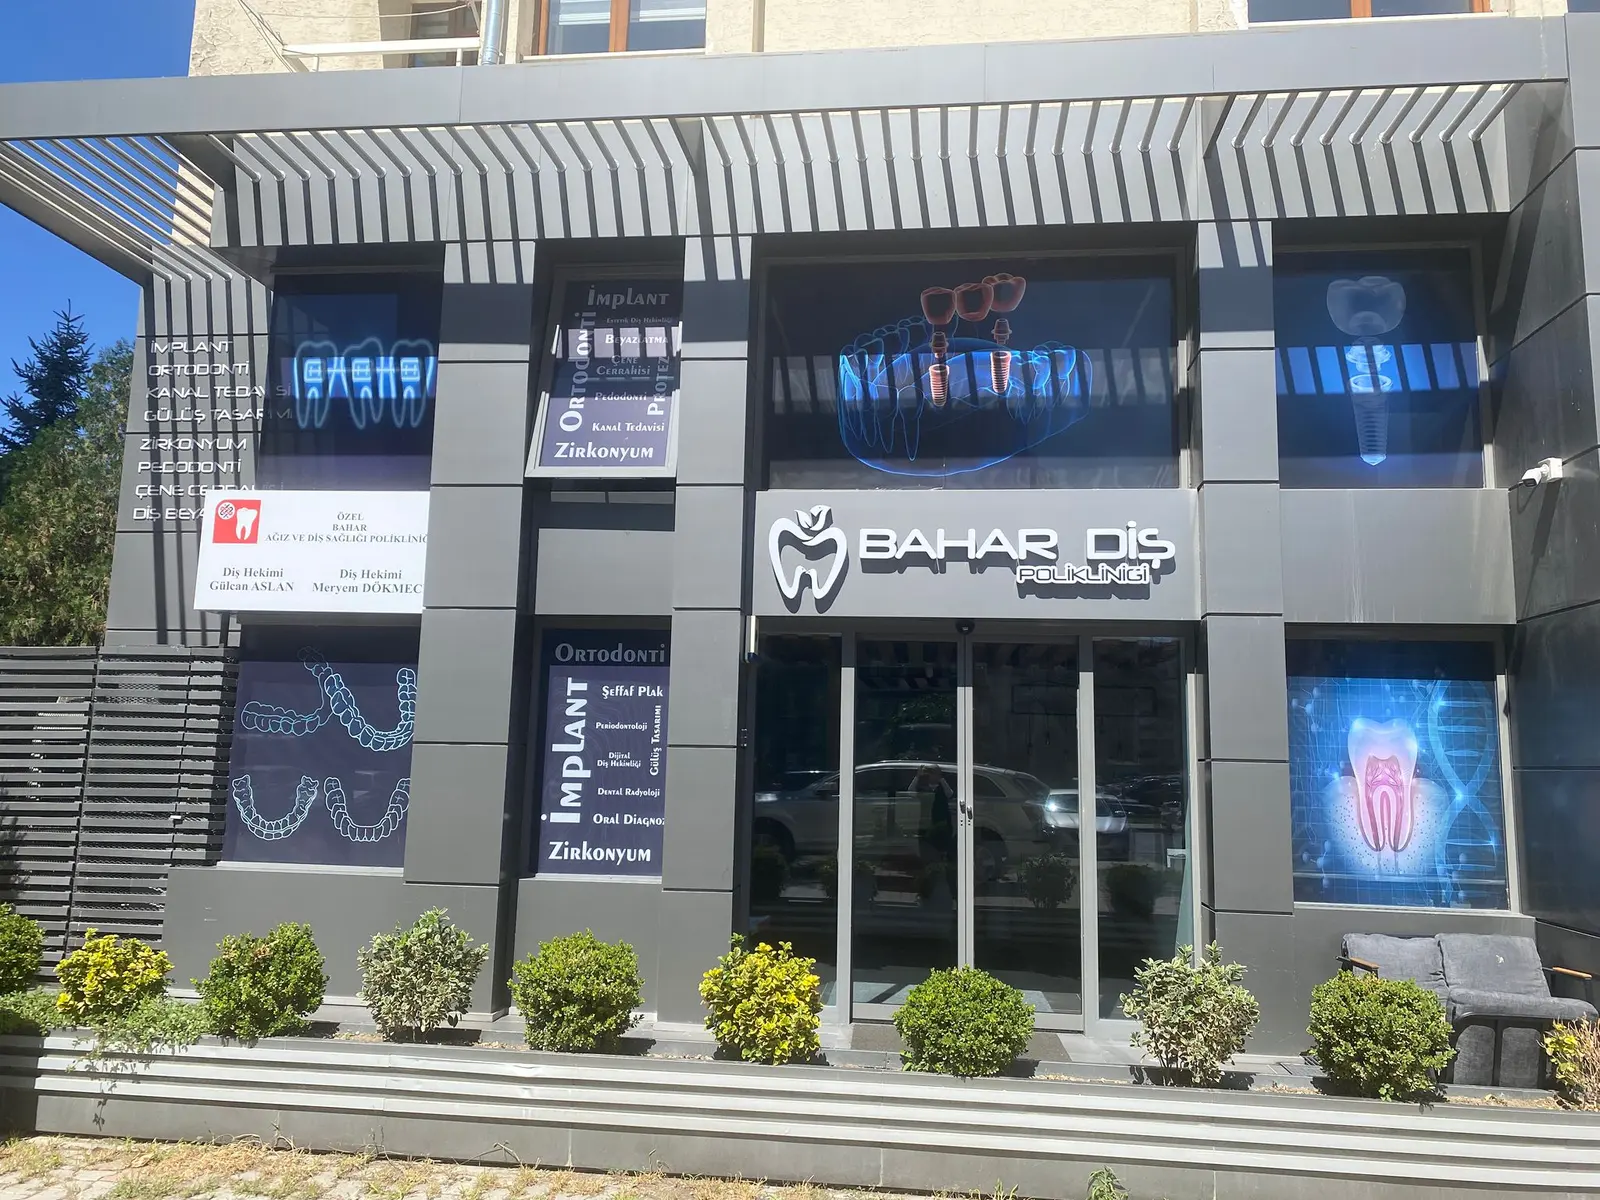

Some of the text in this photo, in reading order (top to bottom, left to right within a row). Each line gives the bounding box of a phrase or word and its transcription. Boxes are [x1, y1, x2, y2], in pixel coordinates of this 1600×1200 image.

[150, 340, 234, 354] İMPLANT
[148, 360, 250, 376] ORTODONTİ
[145, 386, 210, 400] KANAL
[143, 407, 207, 425] GÜLÜŞ
[139, 437, 248, 451] ZİRKONYUM
[137, 459, 243, 473] PEDODONTİ
[135, 484, 185, 500] ÇENE
[132, 505, 162, 522] DİŞ
[337, 511, 364, 521] ÖZEL
[332, 523, 368, 532] BAHAR
[266, 532, 290, 542] AĞIZ
[293, 534, 305, 542] VE
[307, 533, 323, 543] DİŞ
[326, 533, 367, 543] SAĞLIĞI
[860, 520, 1176, 570] BAHAR DİŞ
[223, 566, 284, 579] Diş Hekimi
[339, 568, 402, 581] Diş Hekimi
[209, 580, 295, 592] Gülcan ASLAN
[312, 583, 359, 595] Meryem
